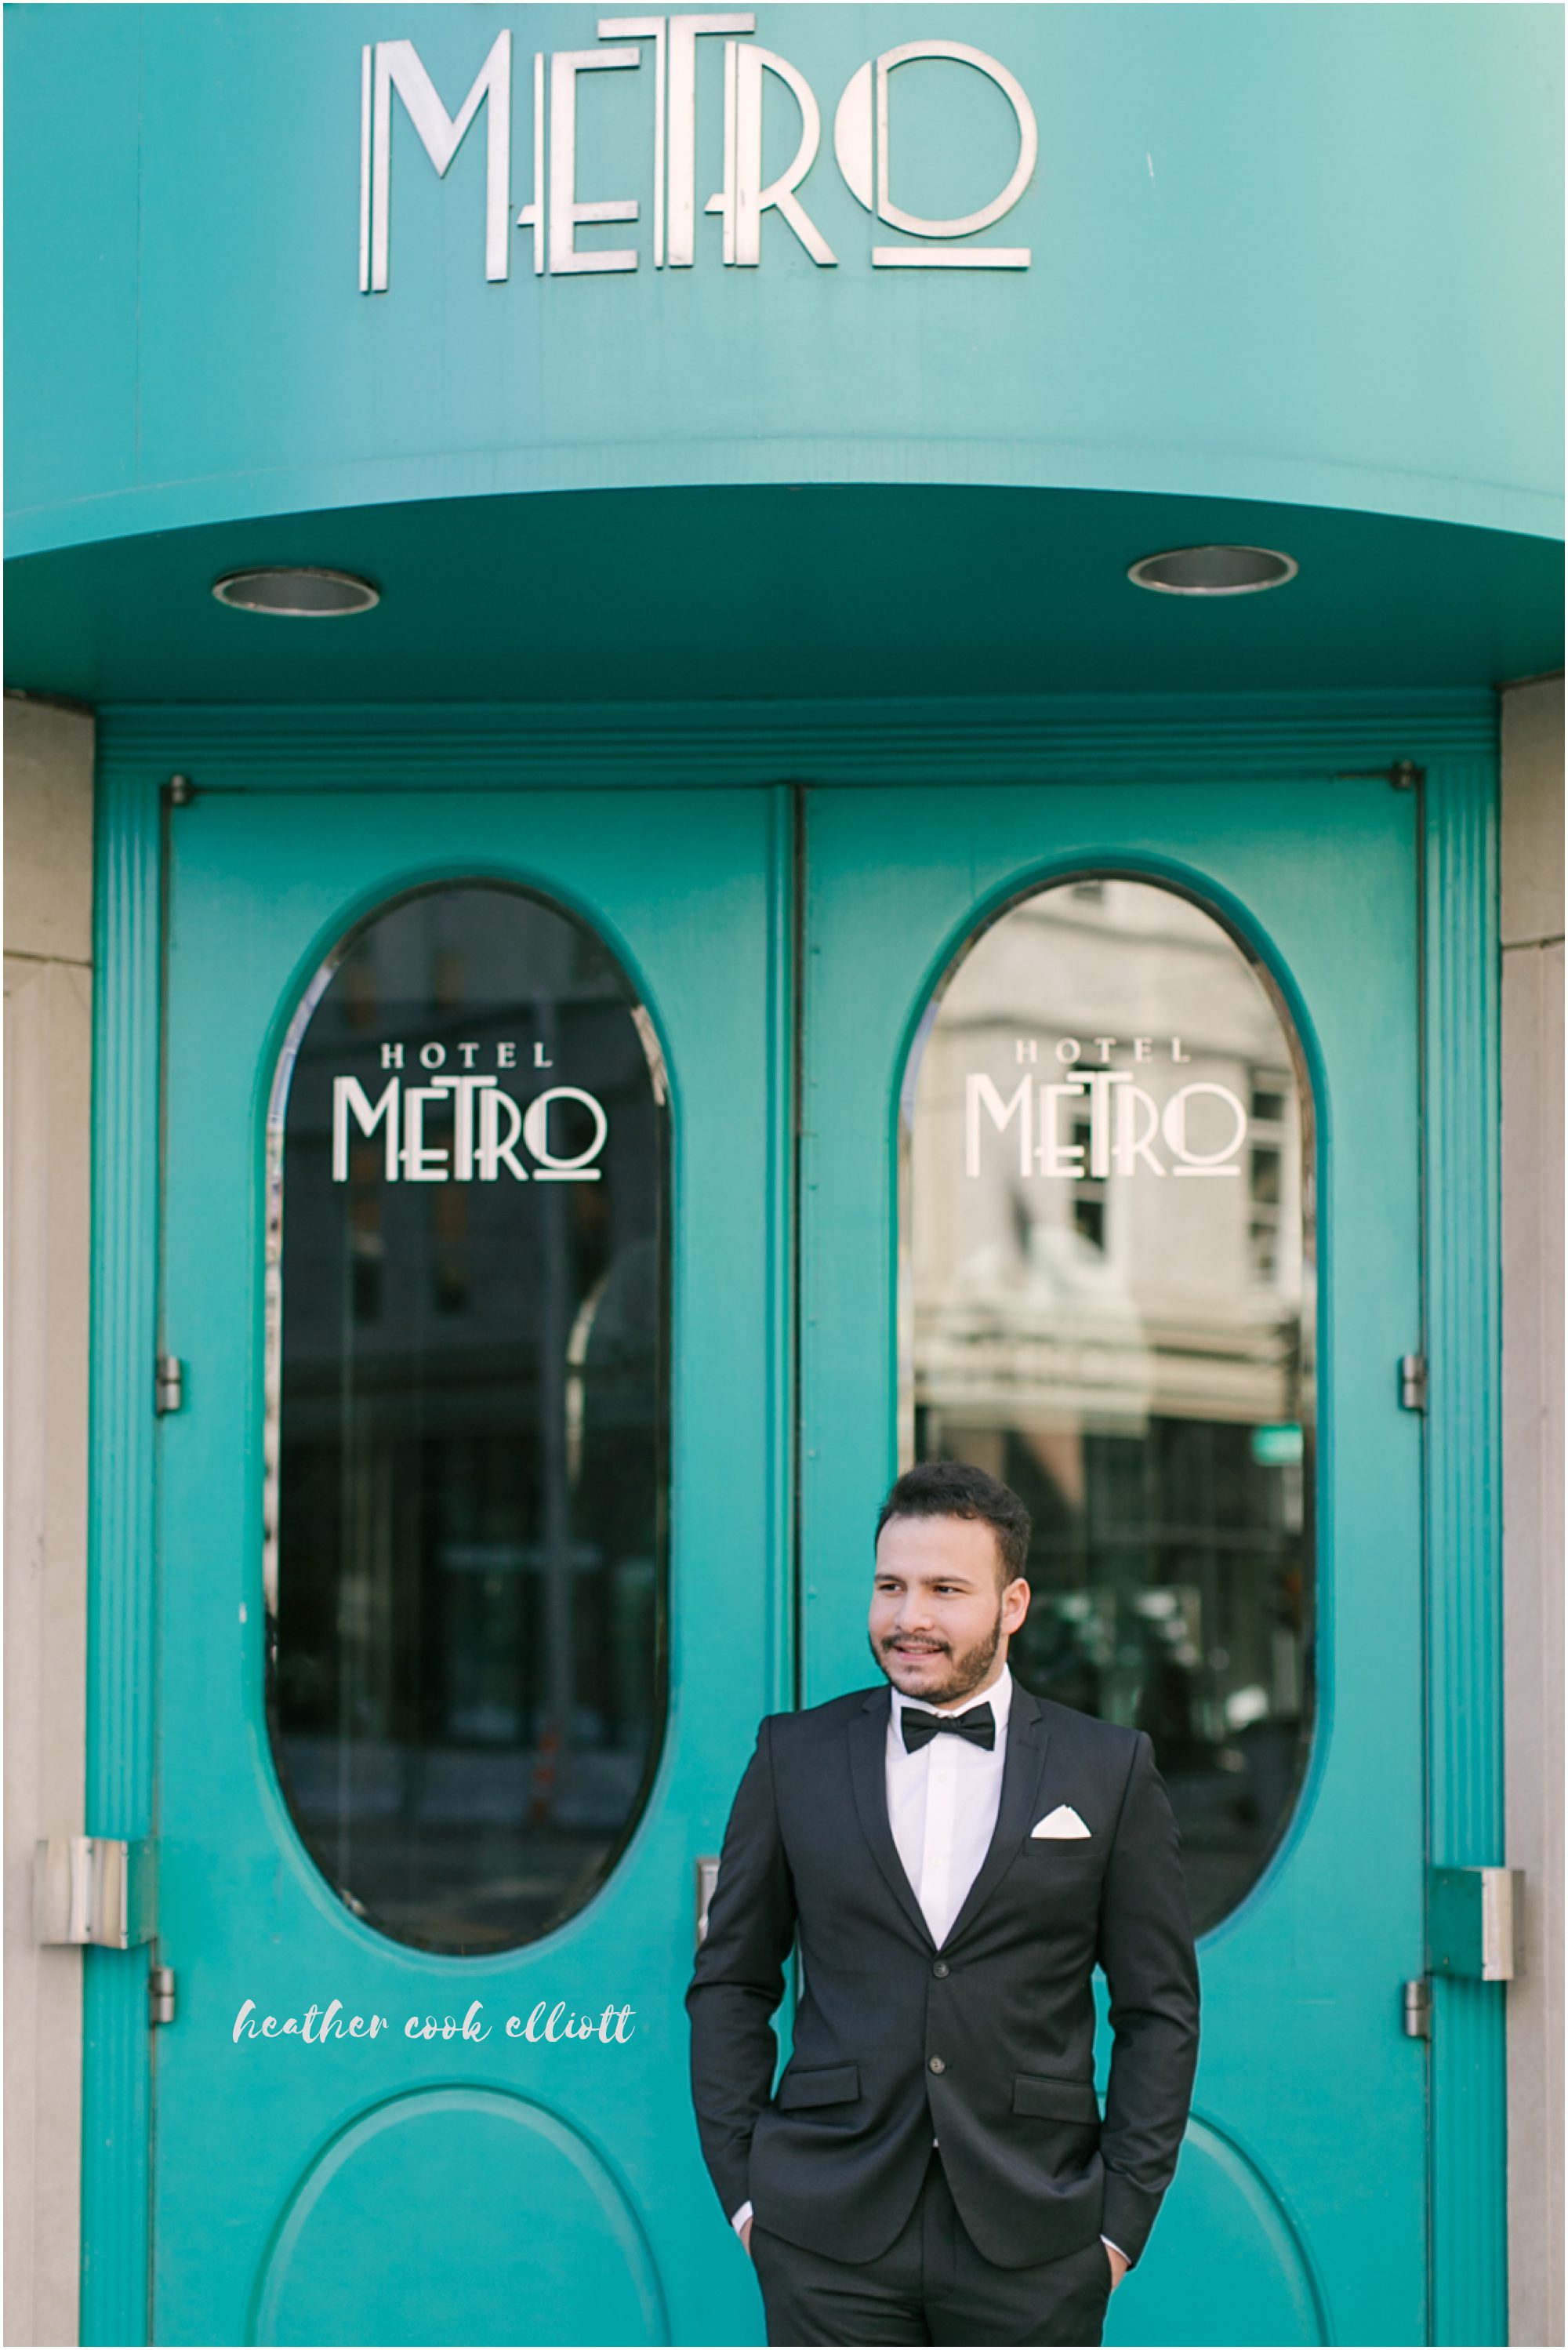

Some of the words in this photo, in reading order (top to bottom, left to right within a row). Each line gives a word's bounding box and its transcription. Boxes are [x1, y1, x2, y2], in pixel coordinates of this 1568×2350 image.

[360, 13, 1037, 293] METRO
[381, 1042, 553, 1069] HOTEL
[1016, 1037, 1190, 1064] HOTEL
[332, 1076, 607, 1182] METRO
[965, 1071, 1247, 1178] METRO
